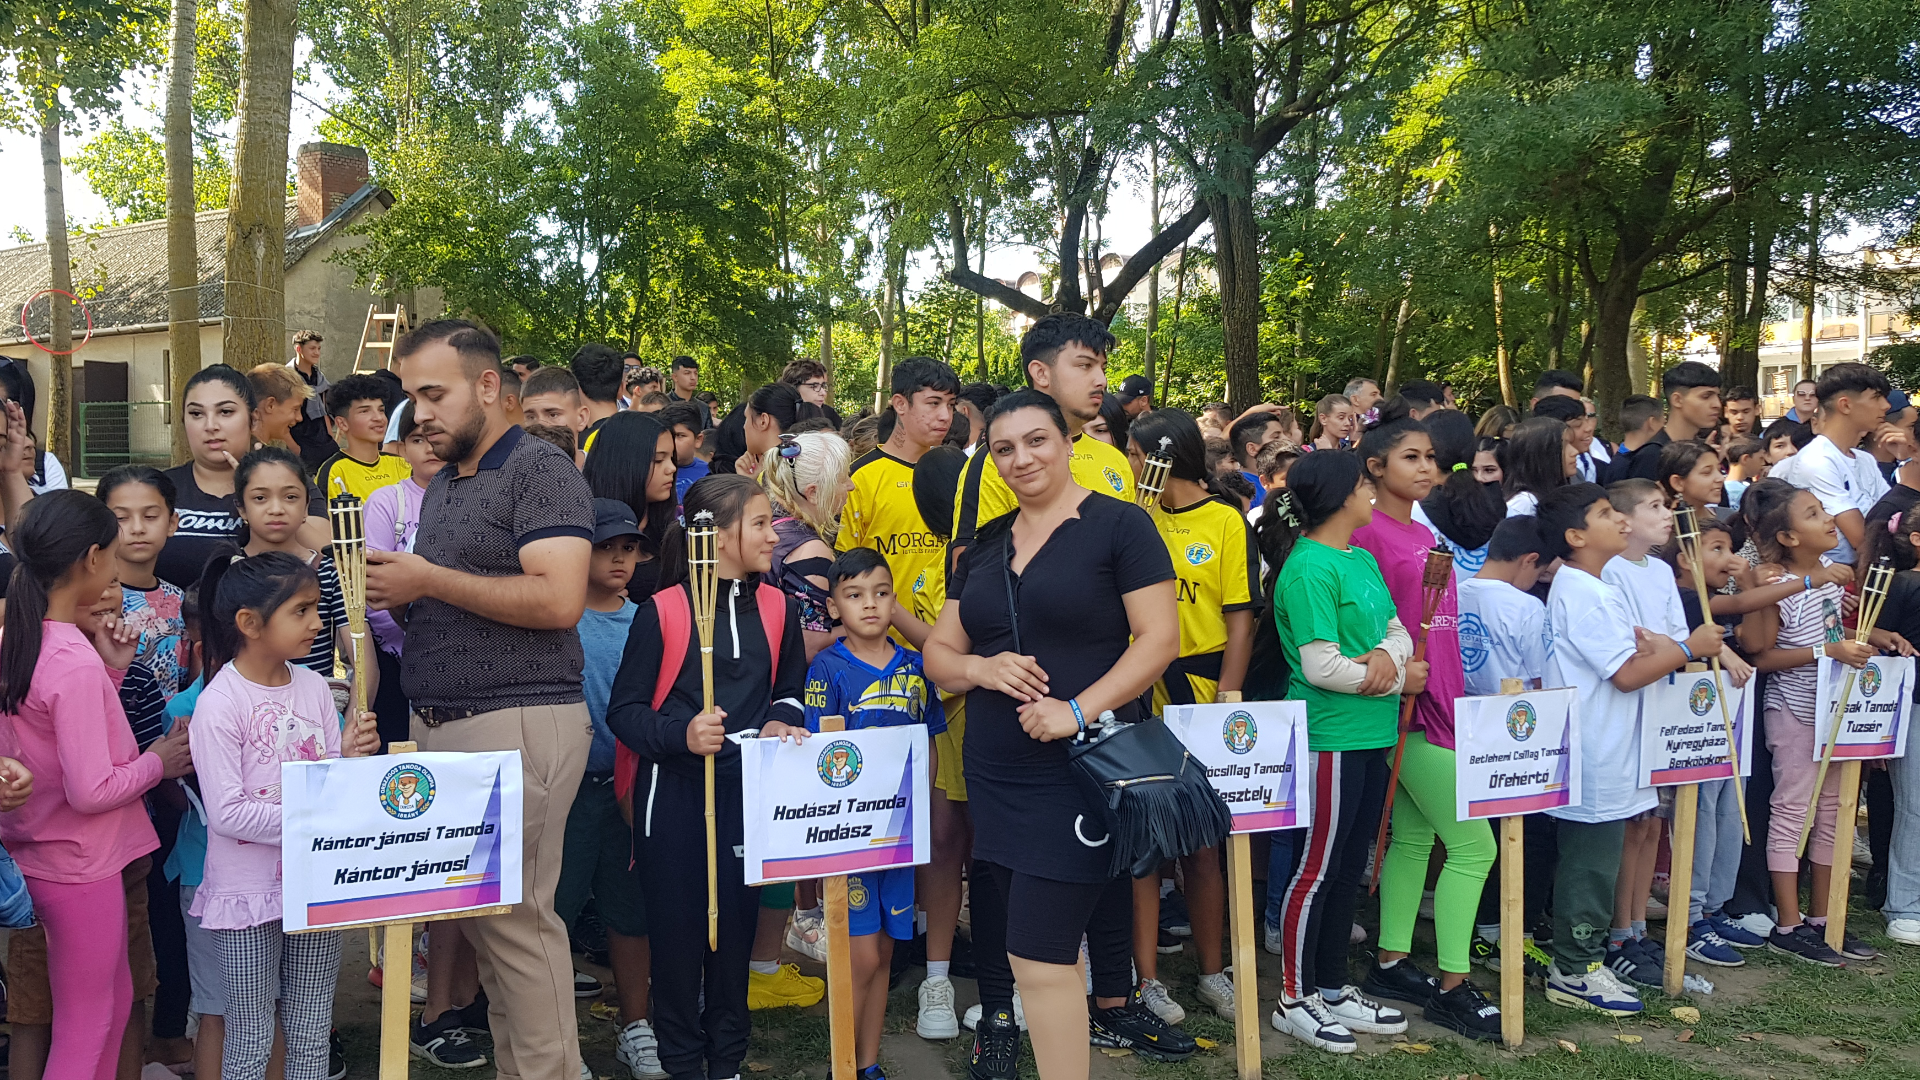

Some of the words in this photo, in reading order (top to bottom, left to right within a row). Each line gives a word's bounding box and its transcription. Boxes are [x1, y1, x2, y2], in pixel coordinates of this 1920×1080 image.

[1865, 700, 1899, 713] Tanoda
[1847, 720, 1883, 733] Tuzsér
[1469, 752, 1511, 764] Betlehemi
[1513, 749, 1539, 761] Csillag
[1541, 745, 1569, 758] Tanoda
[1254, 762, 1292, 775] Tanoda
[1489, 768, 1550, 789] Ófehértó
[773, 800, 842, 821] Hodászi
[847, 794, 907, 813] Tanoda
[436, 821, 494, 840] Tanoda
[805, 822, 873, 844] Hodász
